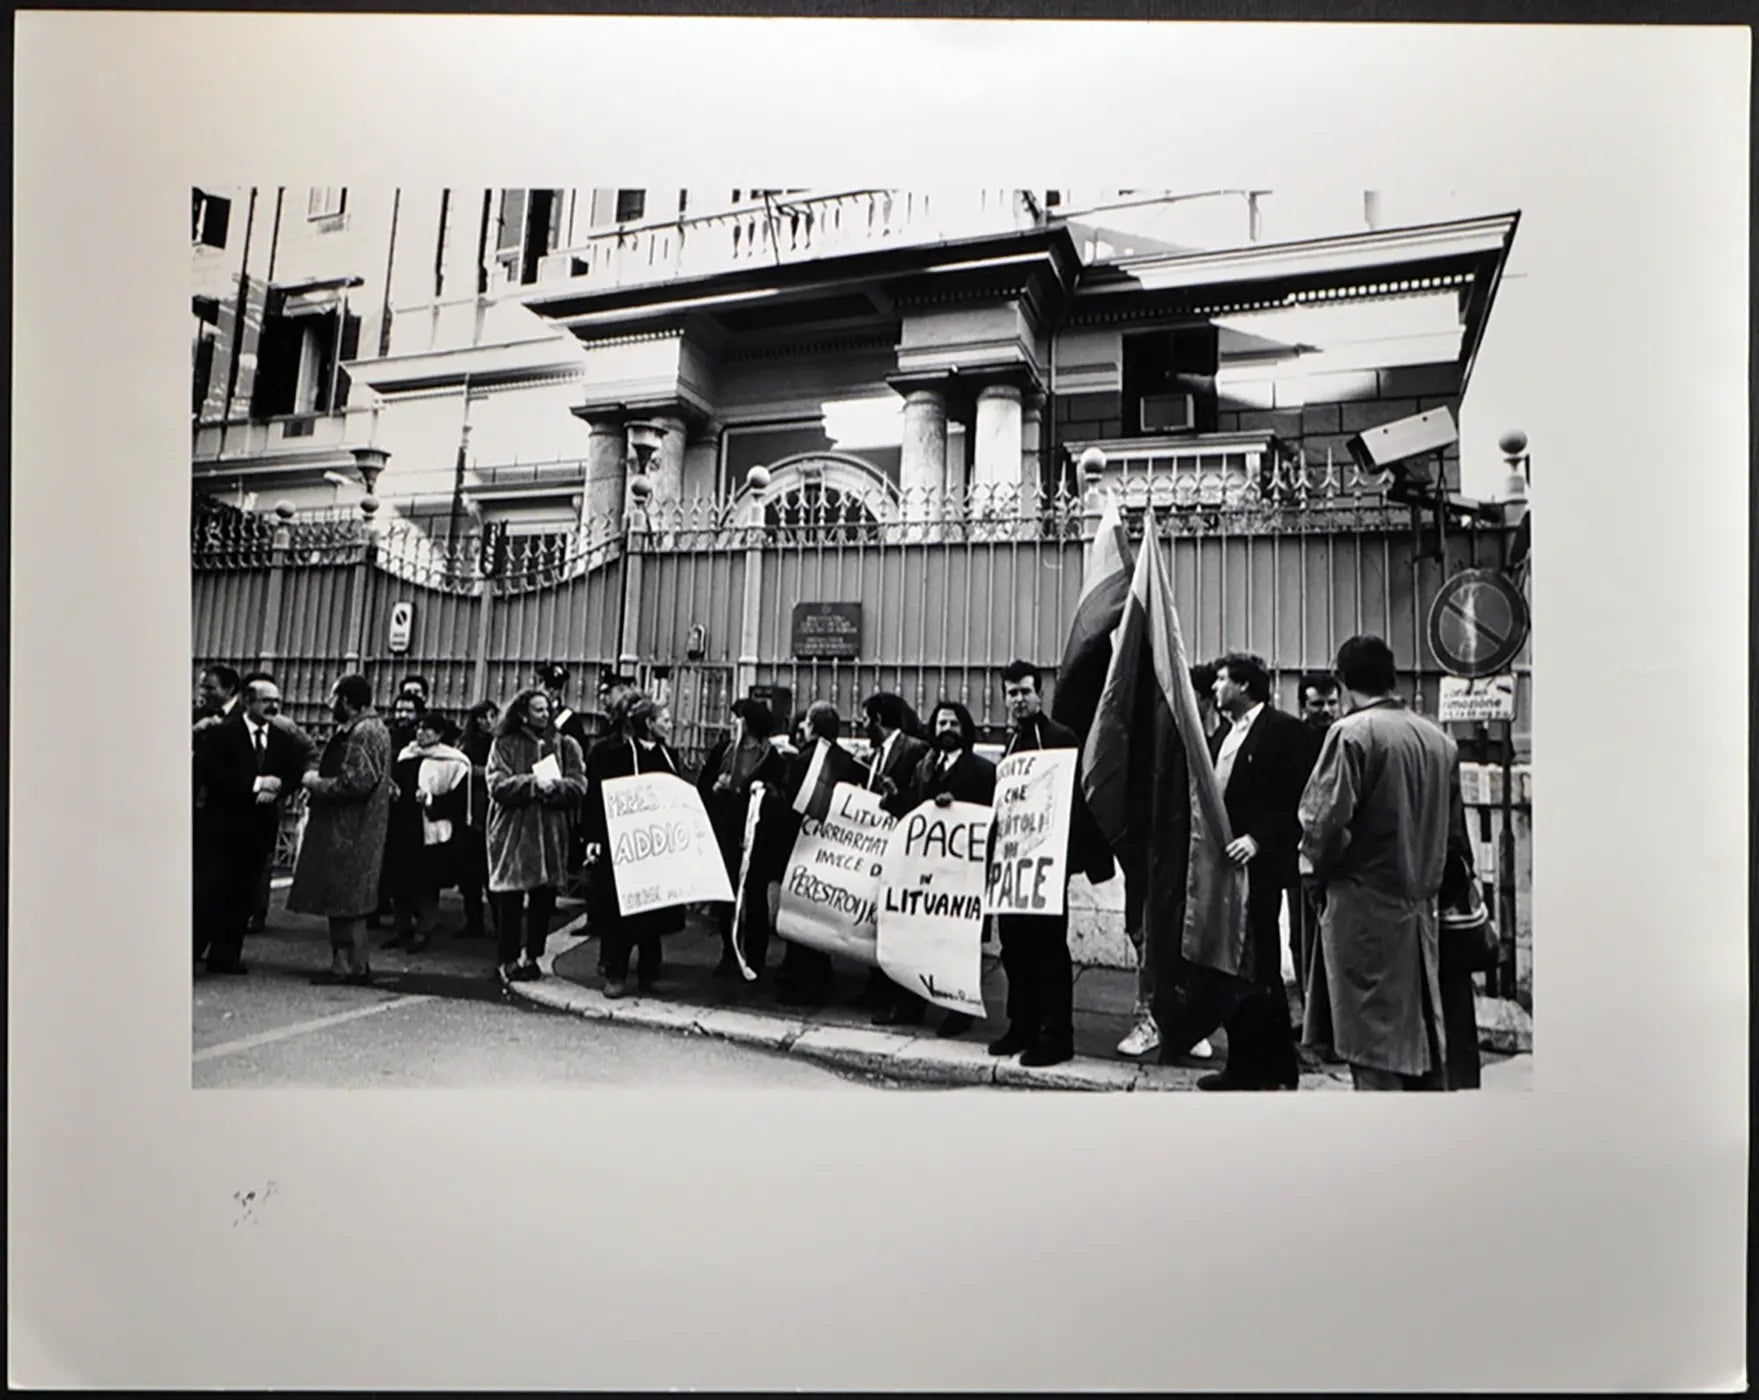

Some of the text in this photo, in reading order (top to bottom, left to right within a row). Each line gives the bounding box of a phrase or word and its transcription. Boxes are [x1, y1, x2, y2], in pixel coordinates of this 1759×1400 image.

[1004, 784, 1028, 804] CHE
[905, 814, 987, 863] PACE
[815, 848, 865, 873] INVECE
[788, 864, 879, 927] PERESTROIJK
[885, 887, 982, 921] LITUANIA
[988, 857, 1054, 910] PACE
